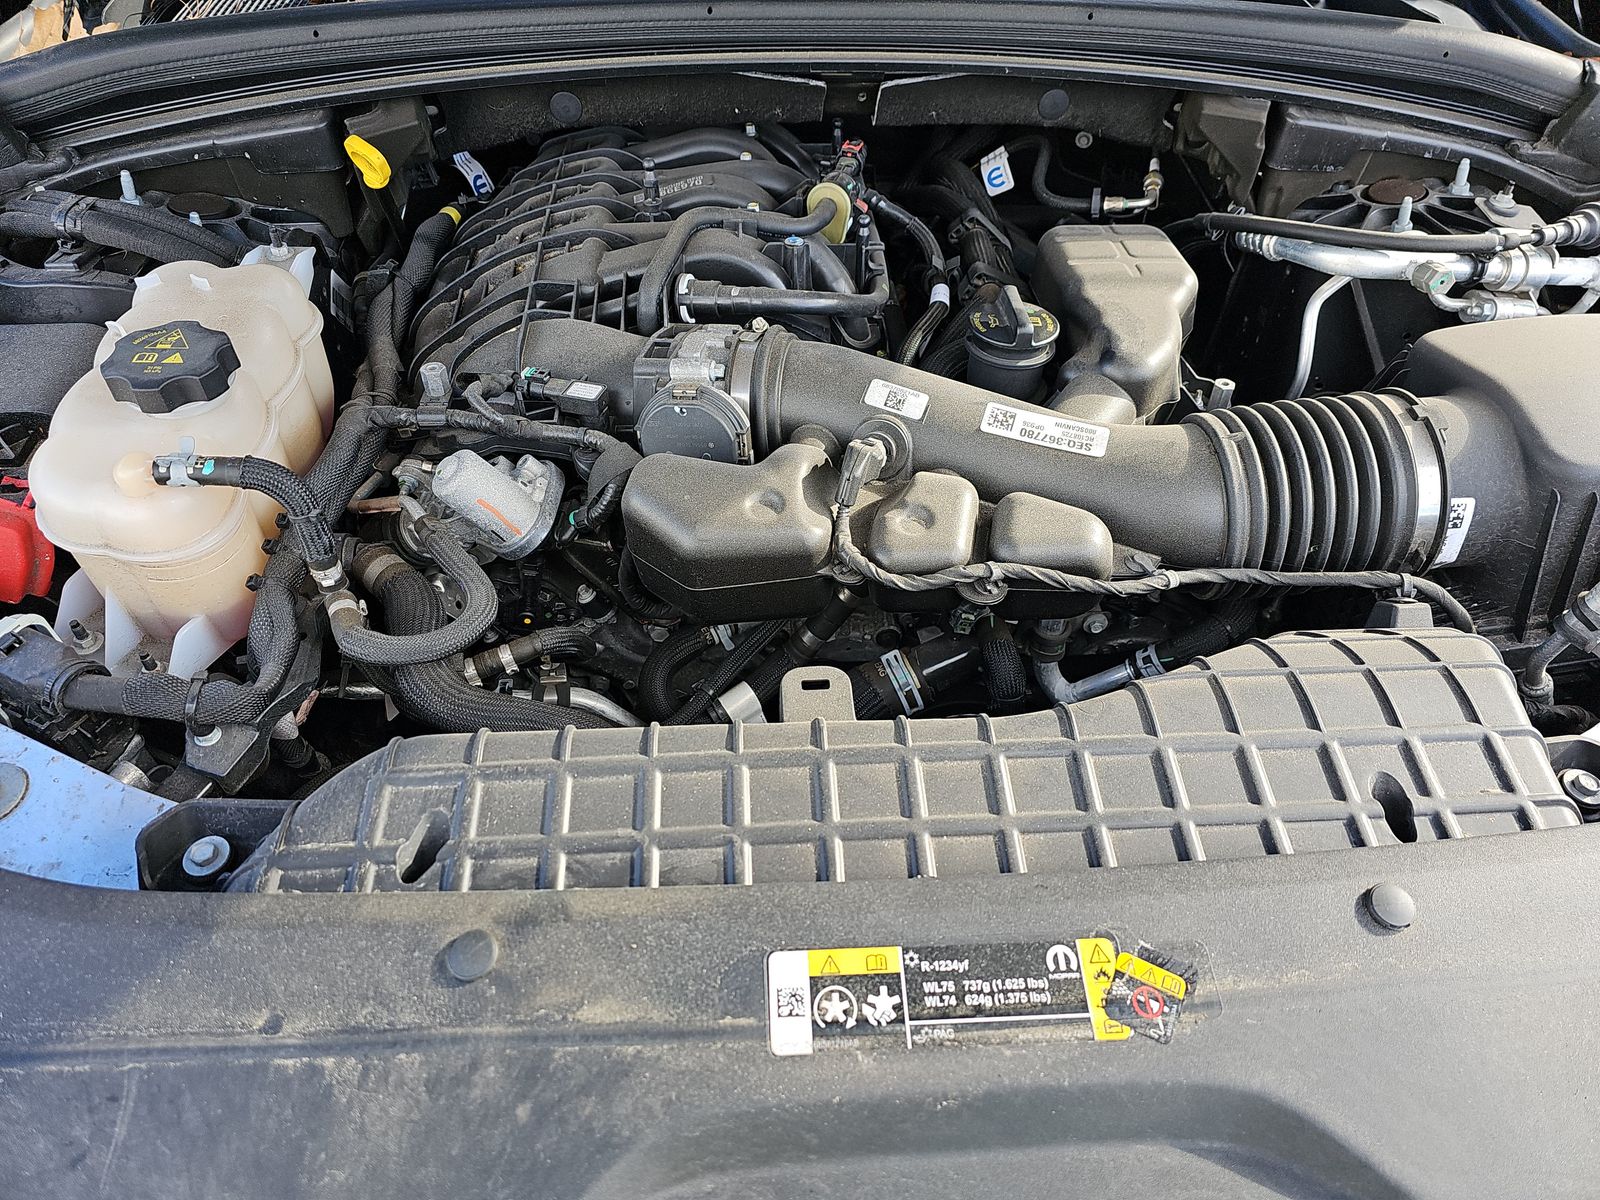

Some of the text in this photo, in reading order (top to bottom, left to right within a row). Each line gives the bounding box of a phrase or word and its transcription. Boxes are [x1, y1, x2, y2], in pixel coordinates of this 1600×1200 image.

[1019, 427, 1093, 452] SEQ:367780
[874, 661, 887, 677] ENG
[920, 958, 970, 973] R-1234yf
[922, 977, 1050, 994] WL75 737g (1.625 lbs)
[924, 990, 1052, 1008] WL74 624g (1.375 lbs)
[933, 1028, 955, 1040] PAG
